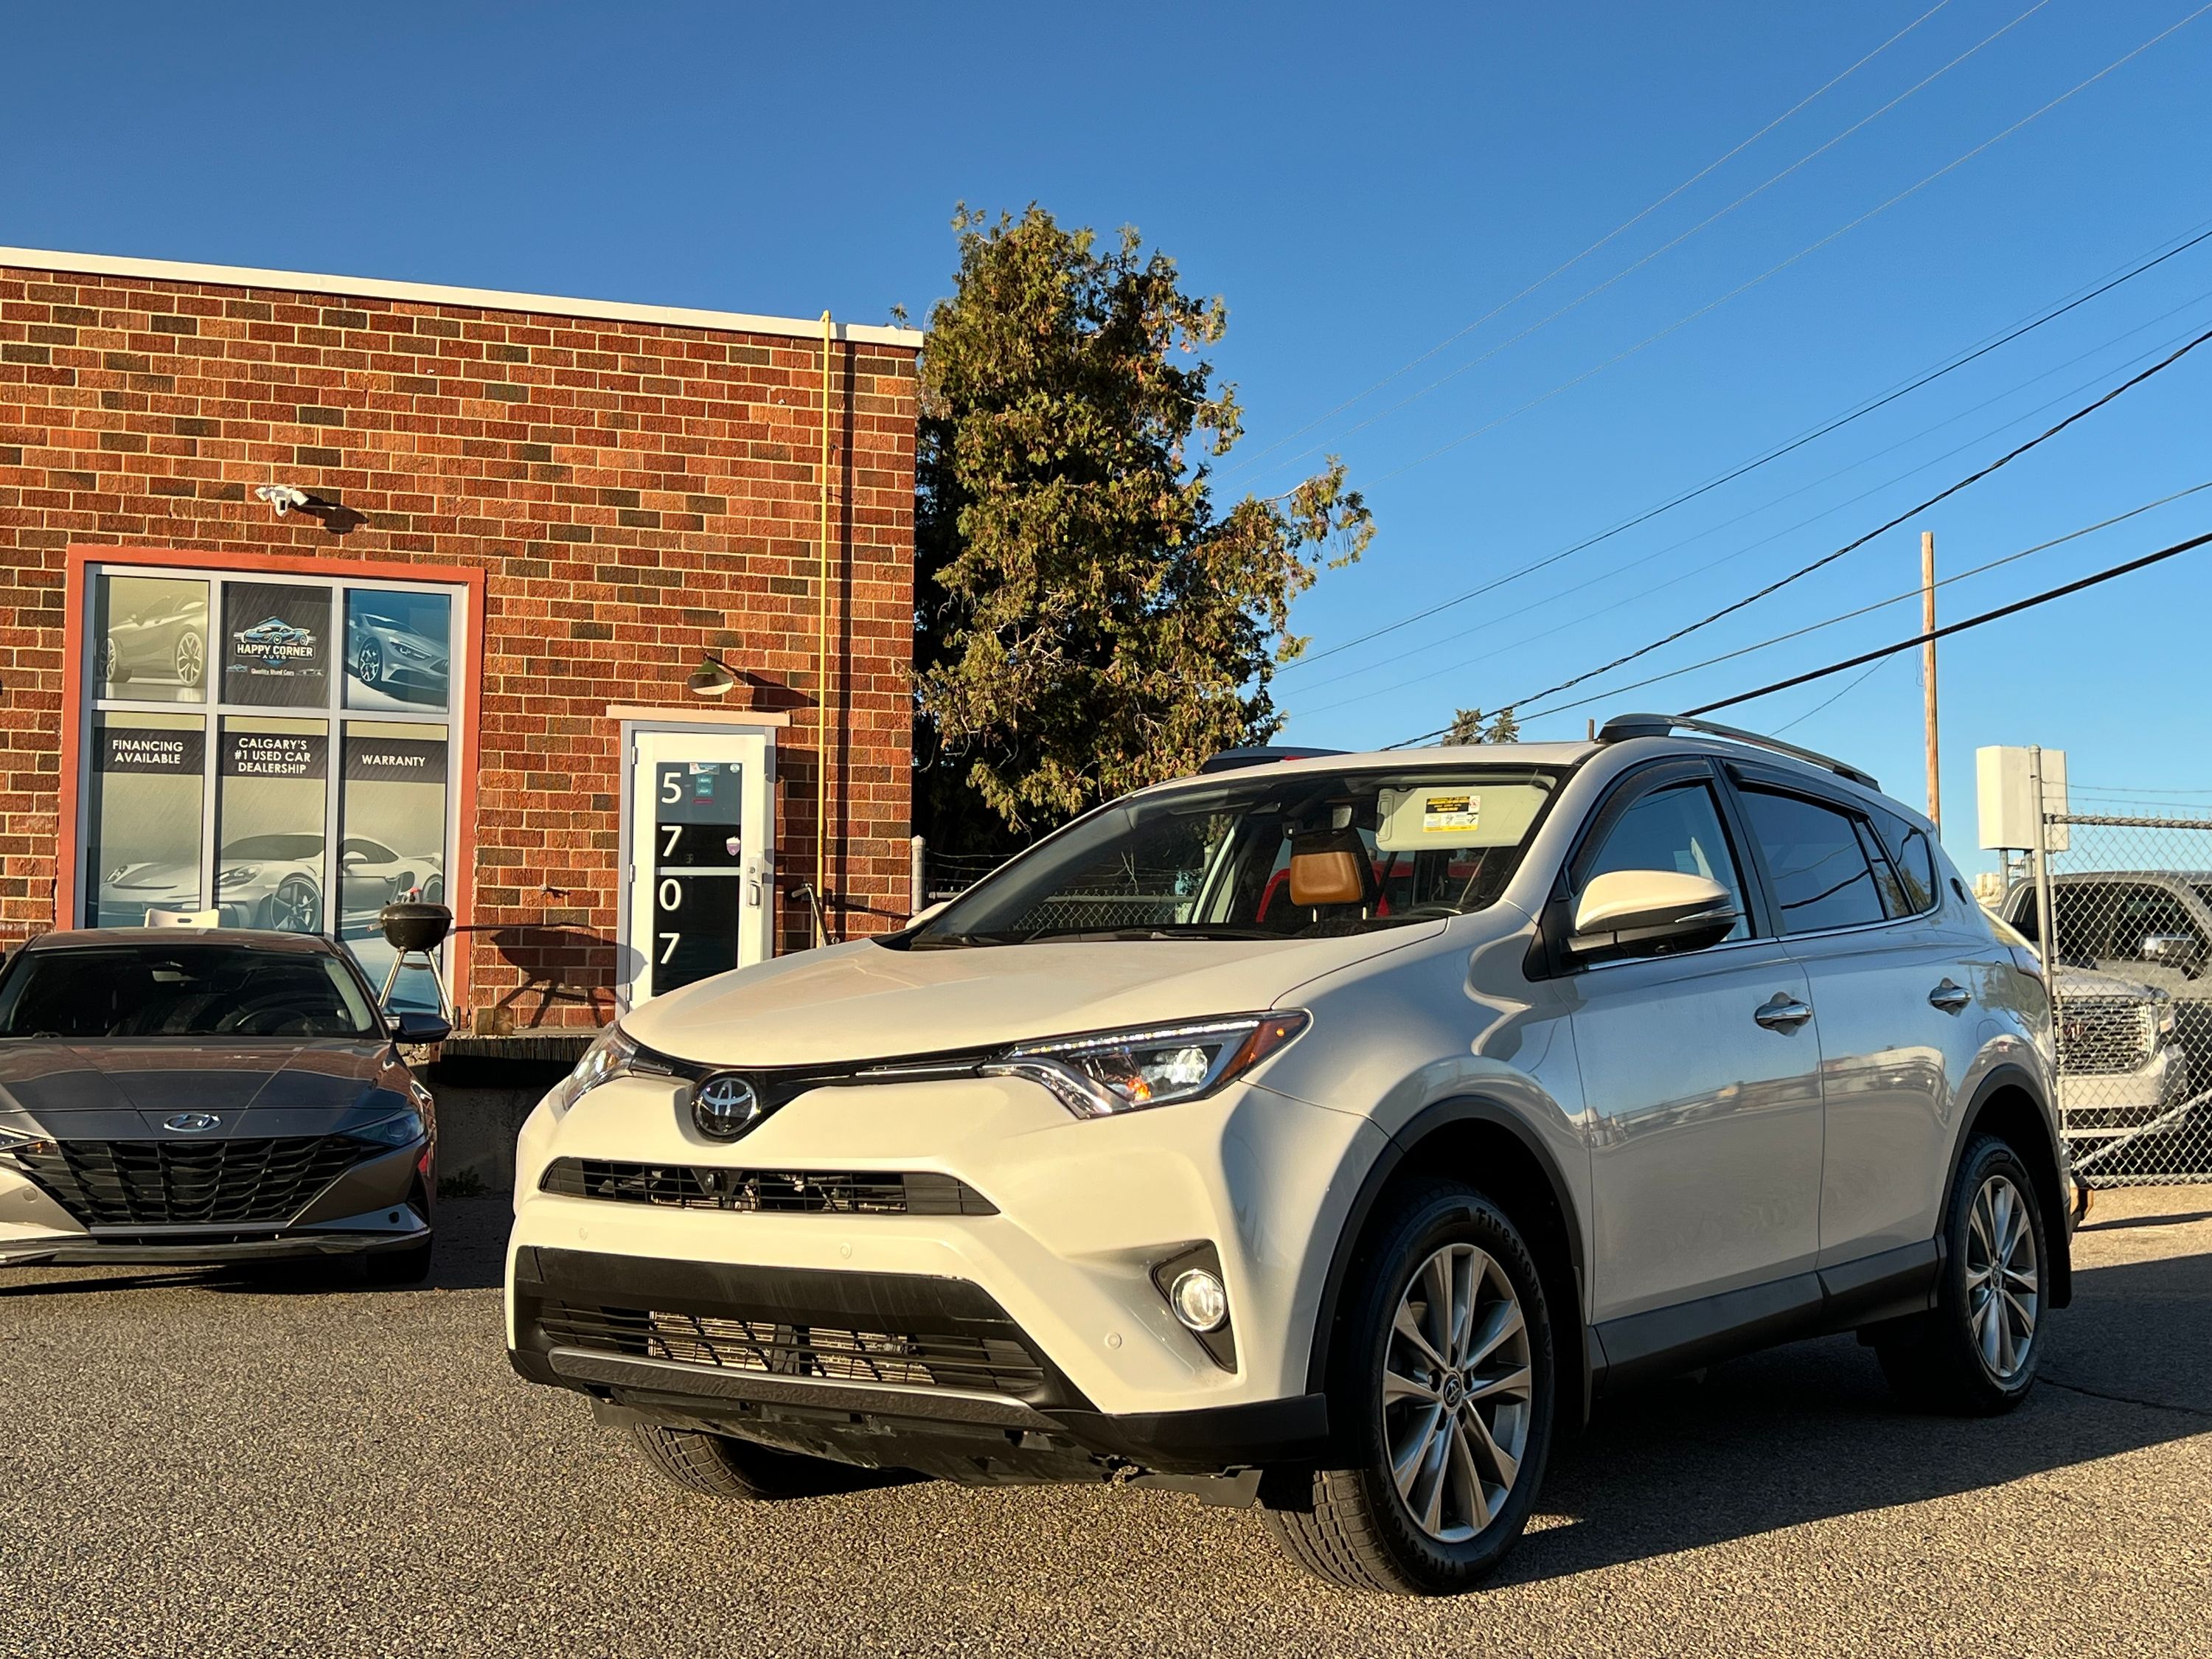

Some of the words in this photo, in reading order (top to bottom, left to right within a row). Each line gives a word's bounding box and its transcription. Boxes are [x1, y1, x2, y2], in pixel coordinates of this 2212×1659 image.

[237, 644, 271, 655] HAPPY
[273, 646, 313, 656] CORNER
[112, 740, 183, 751] FINANCING
[238, 738, 307, 750] CALGARY'S
[114, 753, 181, 764] AVAILABLE
[234, 749, 249, 761] #1
[252, 751, 282, 762] USED
[285, 751, 311, 763] CAR
[361, 754, 425, 767] WARRANTY
[237, 762, 307, 774] DEALERSHIP
[1475, 1206, 1545, 1313] Firestone
